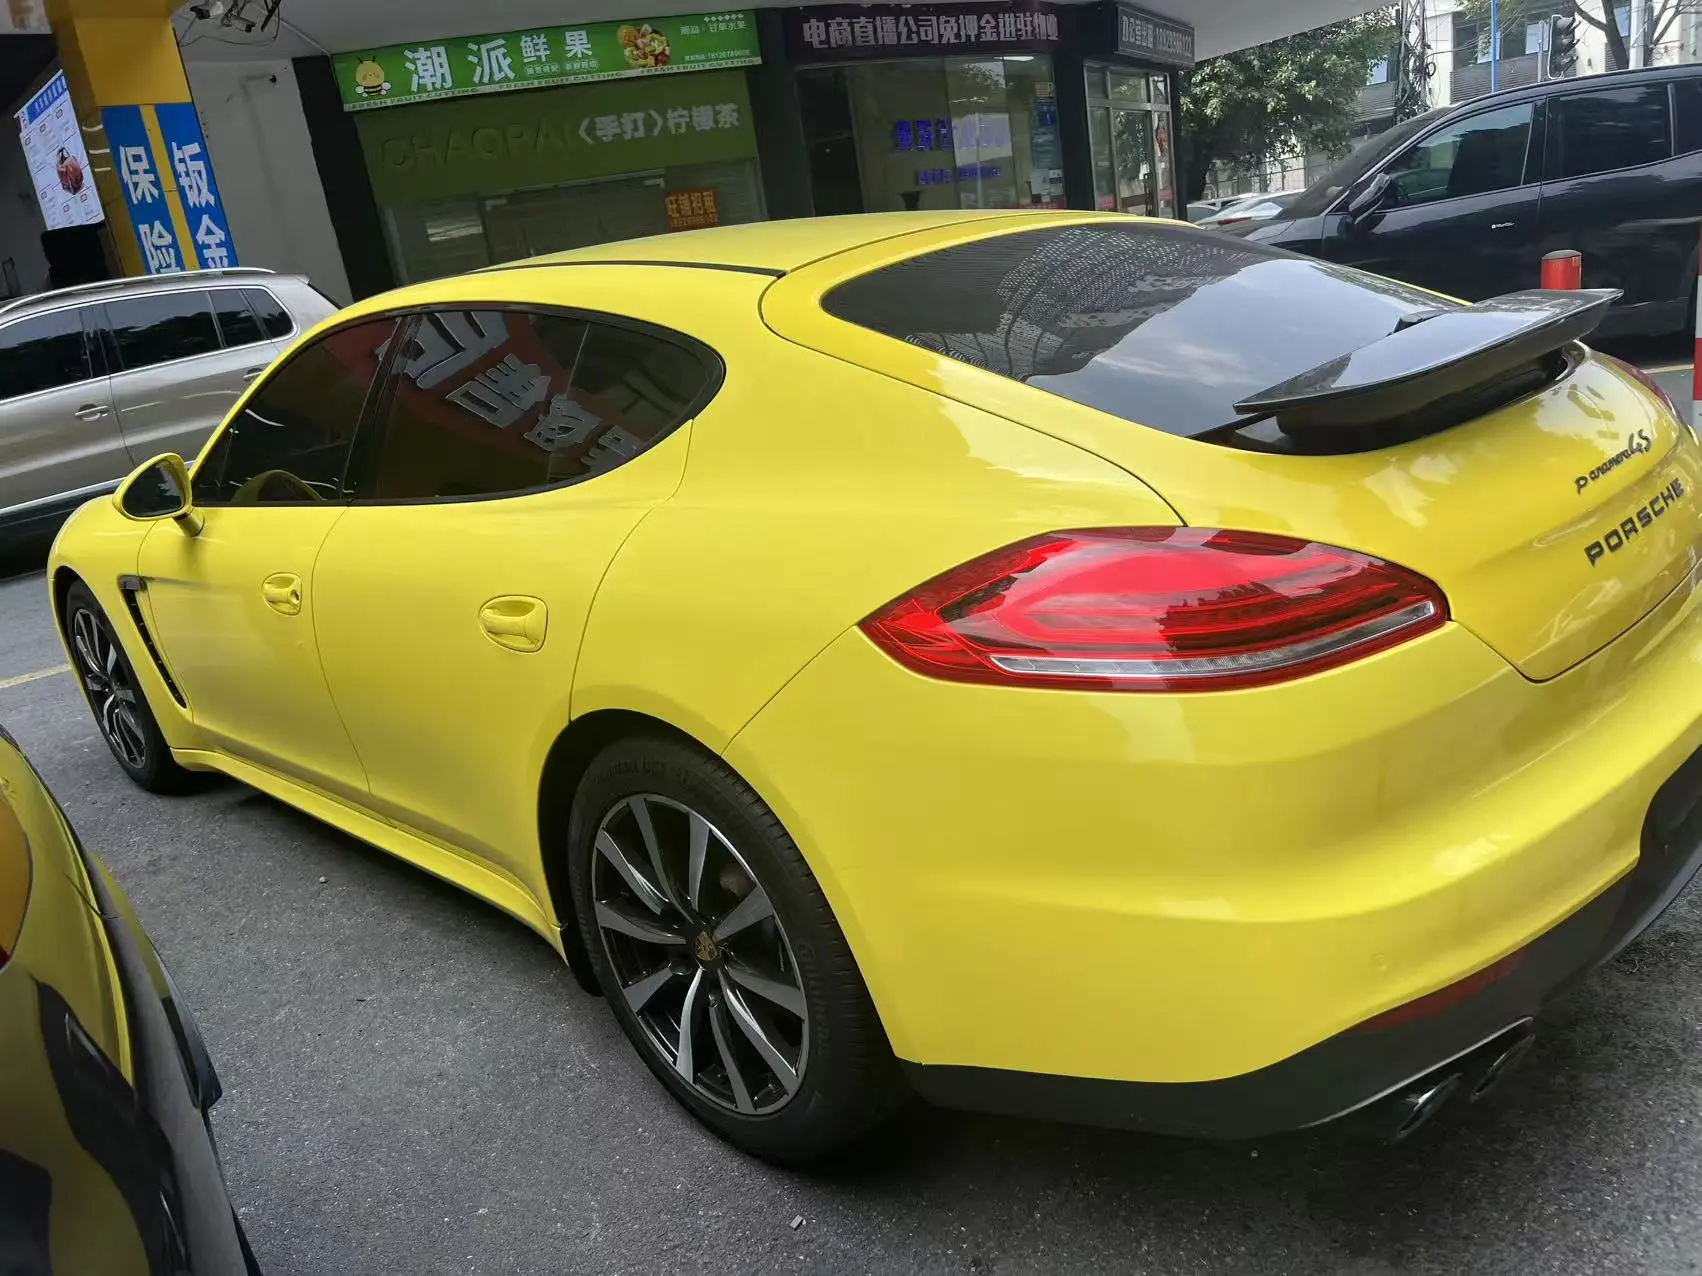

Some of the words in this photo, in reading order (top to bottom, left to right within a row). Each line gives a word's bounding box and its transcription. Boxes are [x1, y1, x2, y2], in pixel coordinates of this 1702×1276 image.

[404, 30, 593, 91] 潮派鲜果
[119, 146, 181, 275] 保险
[172, 141, 230, 271] 钣金
[1575, 449, 1632, 495] Panamera
[1628, 429, 1652, 454] 4S
[1584, 477, 1685, 568] PORSCHE
